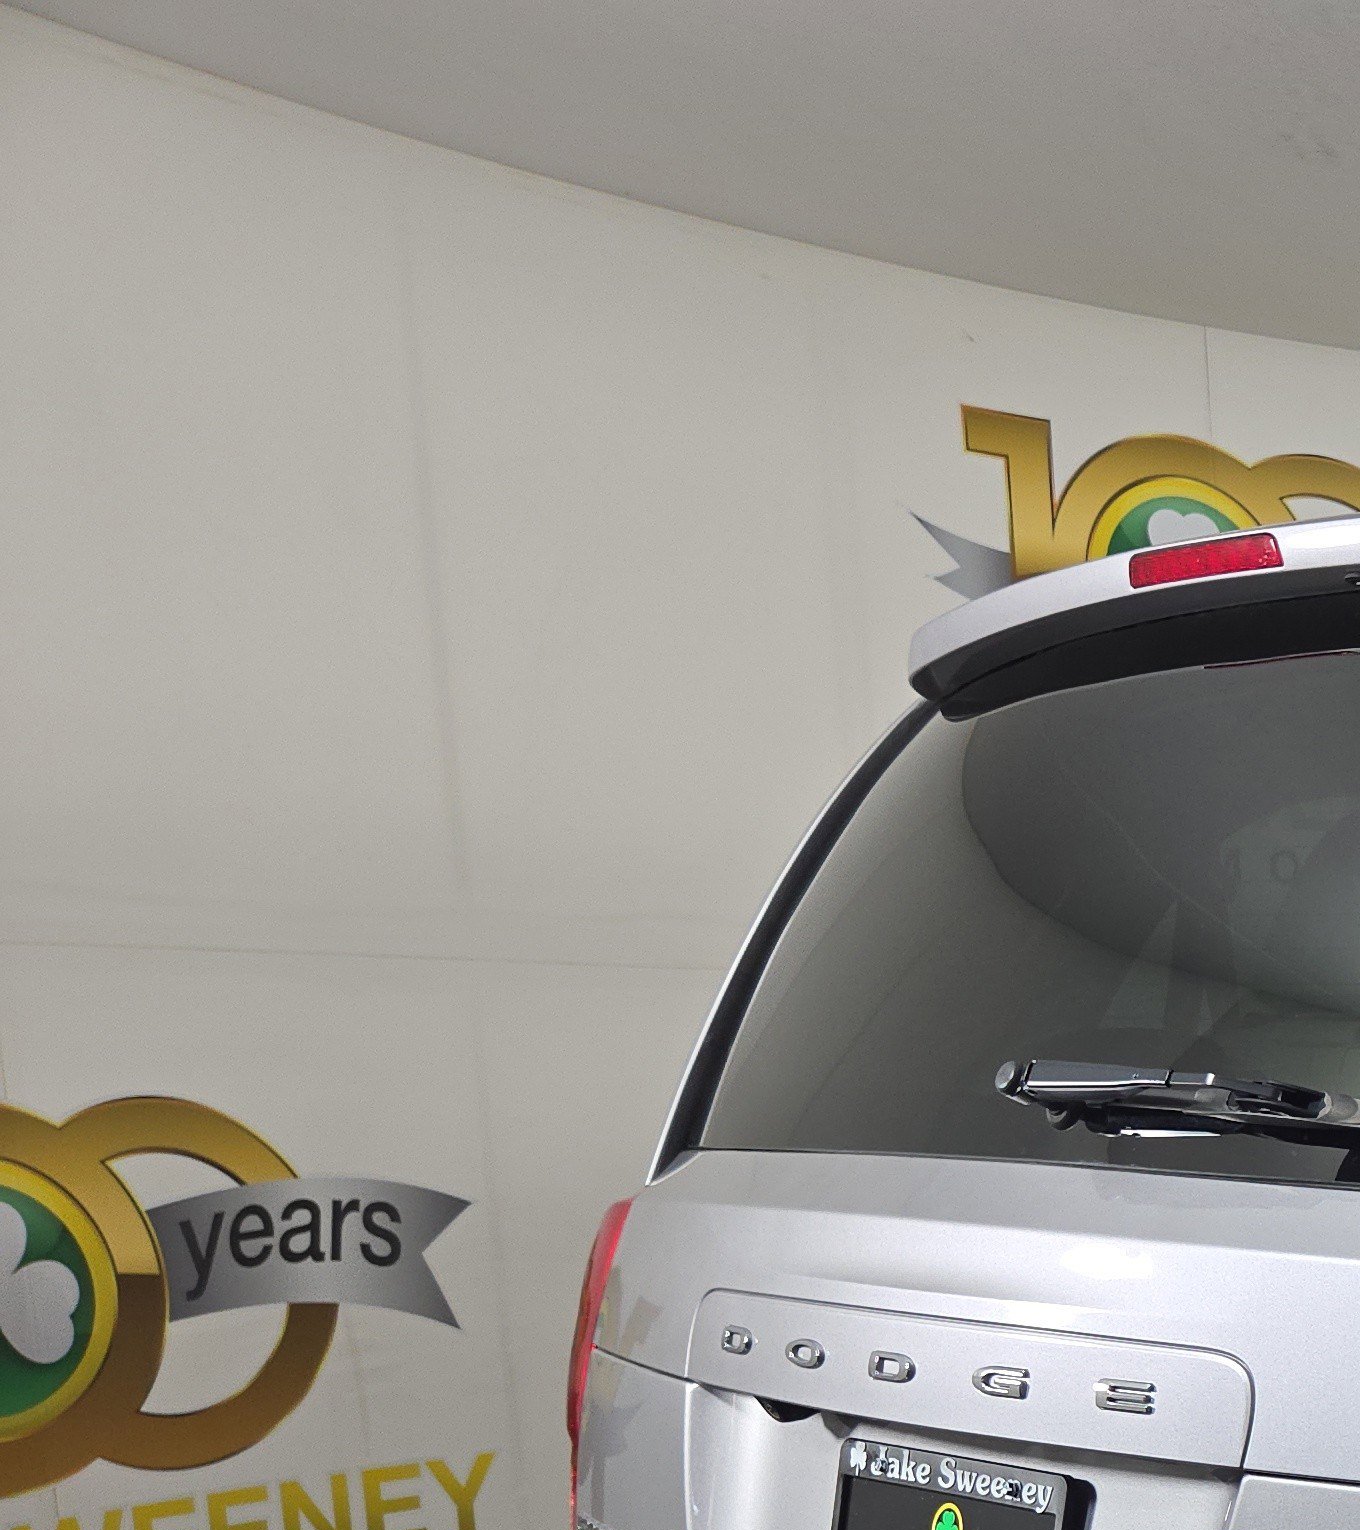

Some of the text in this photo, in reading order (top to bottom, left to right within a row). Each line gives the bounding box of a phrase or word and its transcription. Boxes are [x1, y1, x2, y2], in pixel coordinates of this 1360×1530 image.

[178, 1196, 402, 1299] years
[720, 1323, 1158, 1416] DODGE
[870, 1445, 932, 1485] Jake
